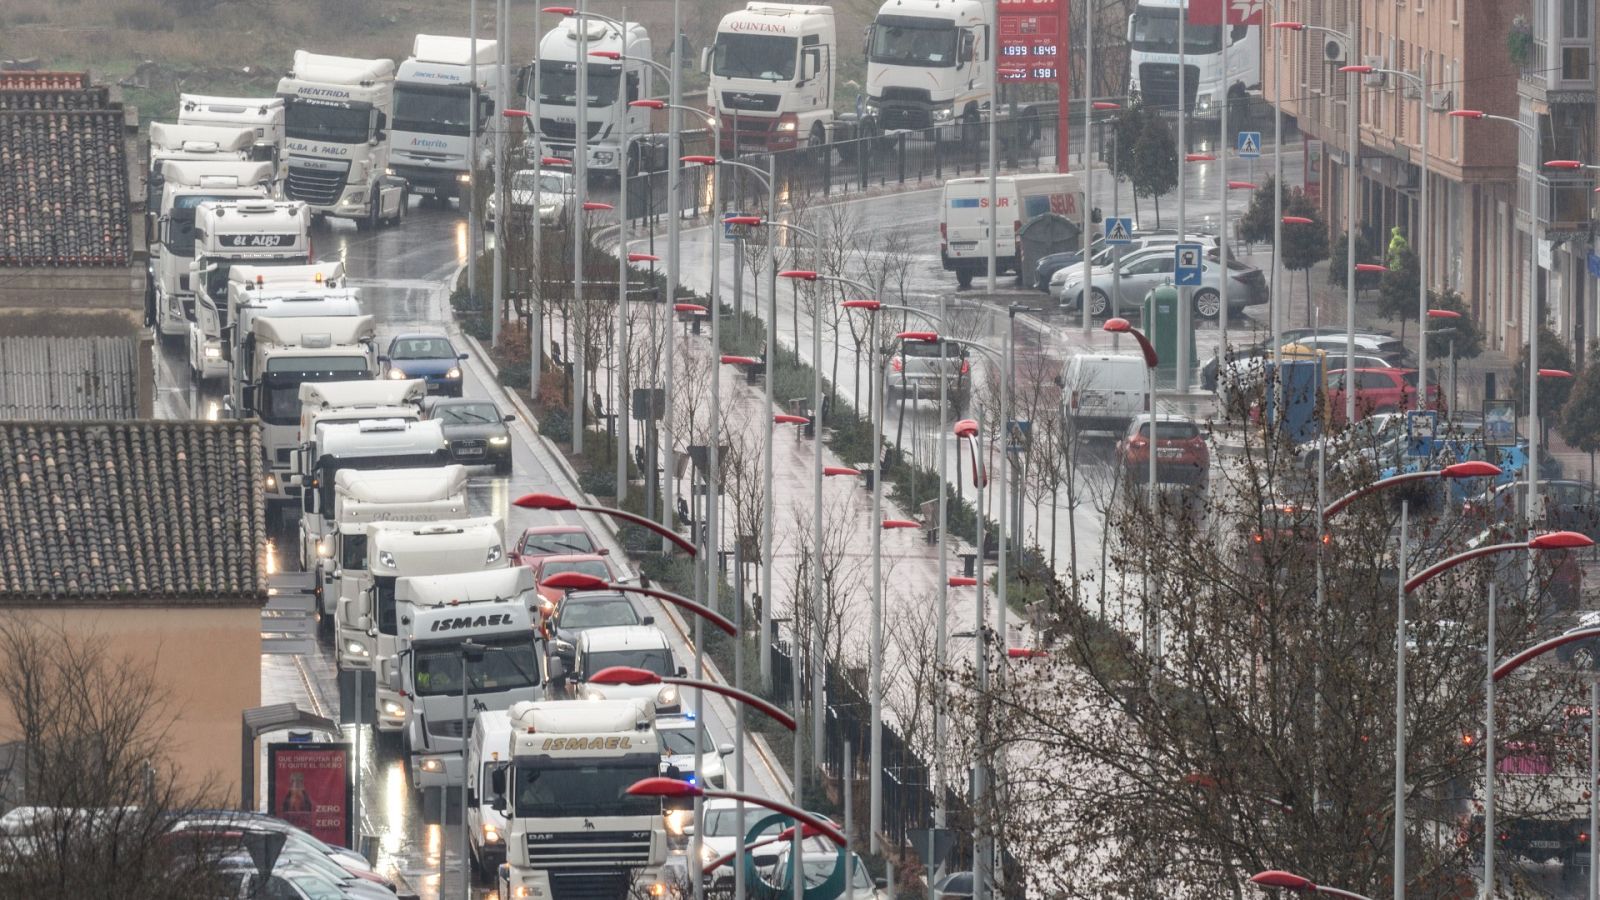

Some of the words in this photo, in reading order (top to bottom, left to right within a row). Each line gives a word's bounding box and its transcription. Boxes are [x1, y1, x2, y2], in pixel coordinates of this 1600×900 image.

[730, 21, 787, 33] QUINTANA
[1004, 45, 1028, 56] 1.899
[1034, 45, 1057, 56] 1.849
[1034, 68, 1057, 78] 1.981
[298, 87, 350, 98] MENTRIDA
[287, 143, 308, 152] ALBA
[312, 145, 318, 153] &
[322, 146, 347, 155] PABLO
[411, 138, 448, 149] Arturito
[981, 197, 1009, 208] SUR
[1050, 192, 1076, 214] SEUR
[430, 614, 513, 632] ISMAEL
[542, 736, 633, 751] ISMAEL
[316, 805, 341, 813] ZERO
[316, 819, 341, 827] ZERO
[631, 831, 649, 839] XF
